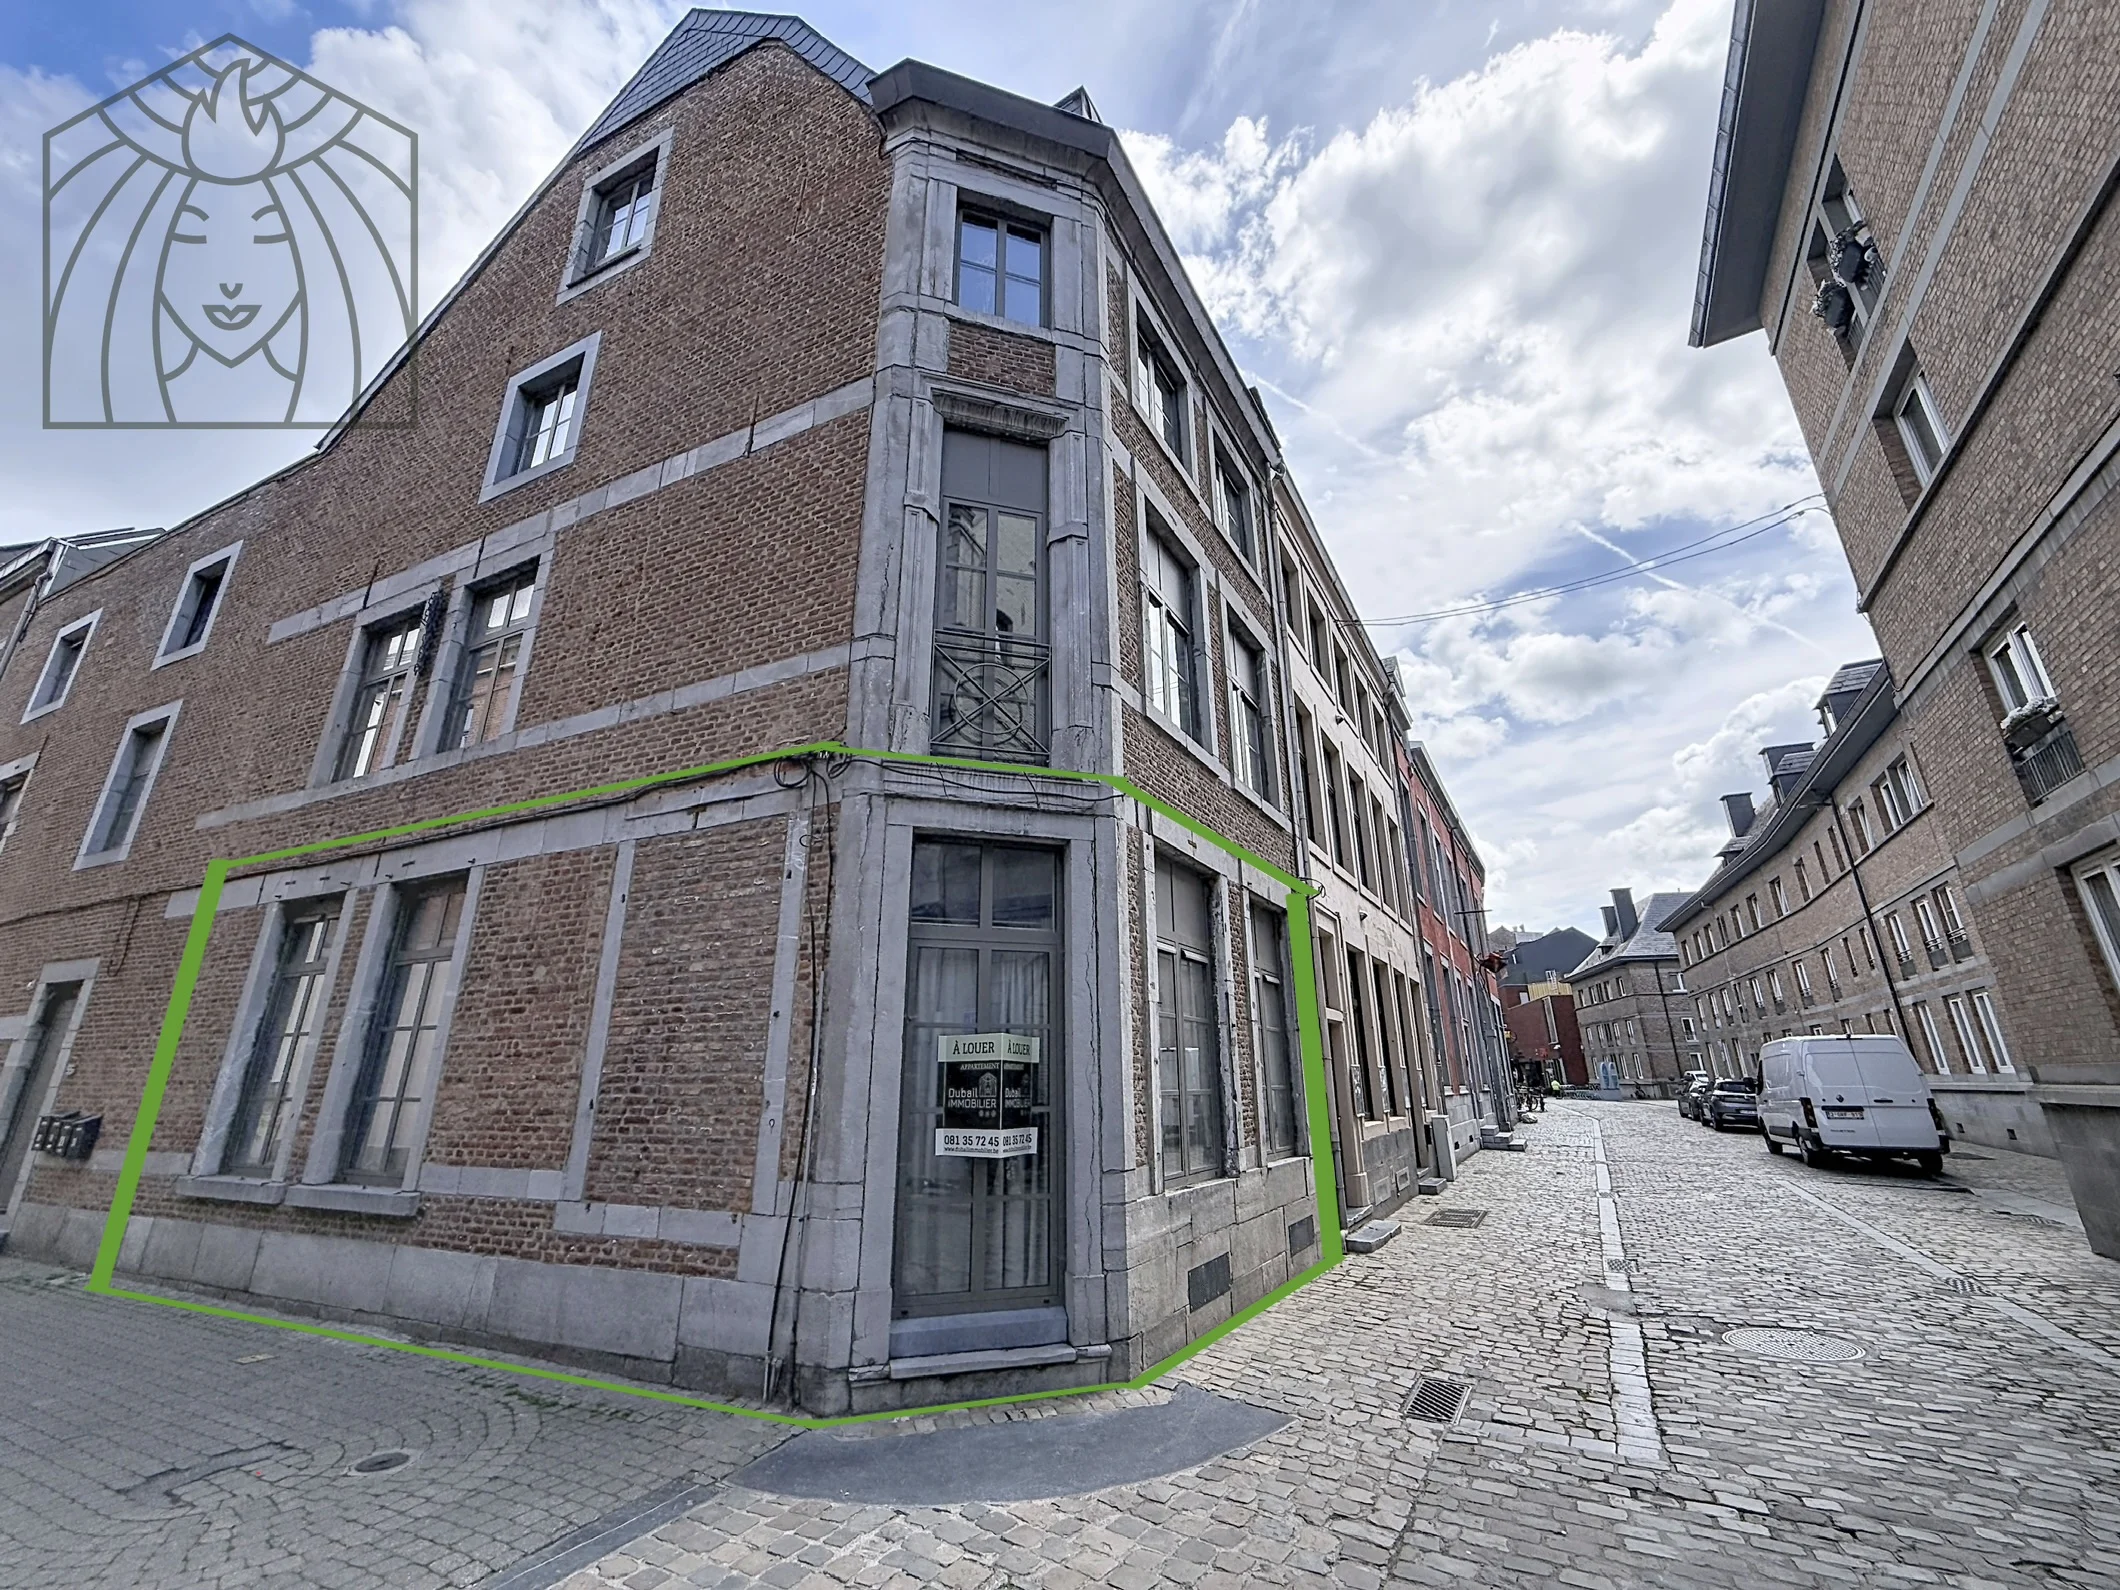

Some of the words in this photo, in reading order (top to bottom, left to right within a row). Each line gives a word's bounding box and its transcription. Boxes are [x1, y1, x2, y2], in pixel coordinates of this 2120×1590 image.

[953, 1040, 960, 1055] À
[962, 1041, 995, 1055] LOUER
[1008, 1039, 1012, 1054] À
[1012, 1042, 1031, 1055] LOUER
[960, 1062, 1000, 1070] APPARTEMENT
[948, 1087, 978, 1098] Dubail
[944, 1134, 960, 1146] 081
[962, 1135, 973, 1146] 35
[975, 1135, 986, 1147] 72
[988, 1136, 1000, 1147] 45
[1003, 1135, 1011, 1147] 081
[1012, 1135, 1018, 1146] 35
[1019, 1134, 1025, 1145] 72
[1024, 1133, 1032, 1144] 45
